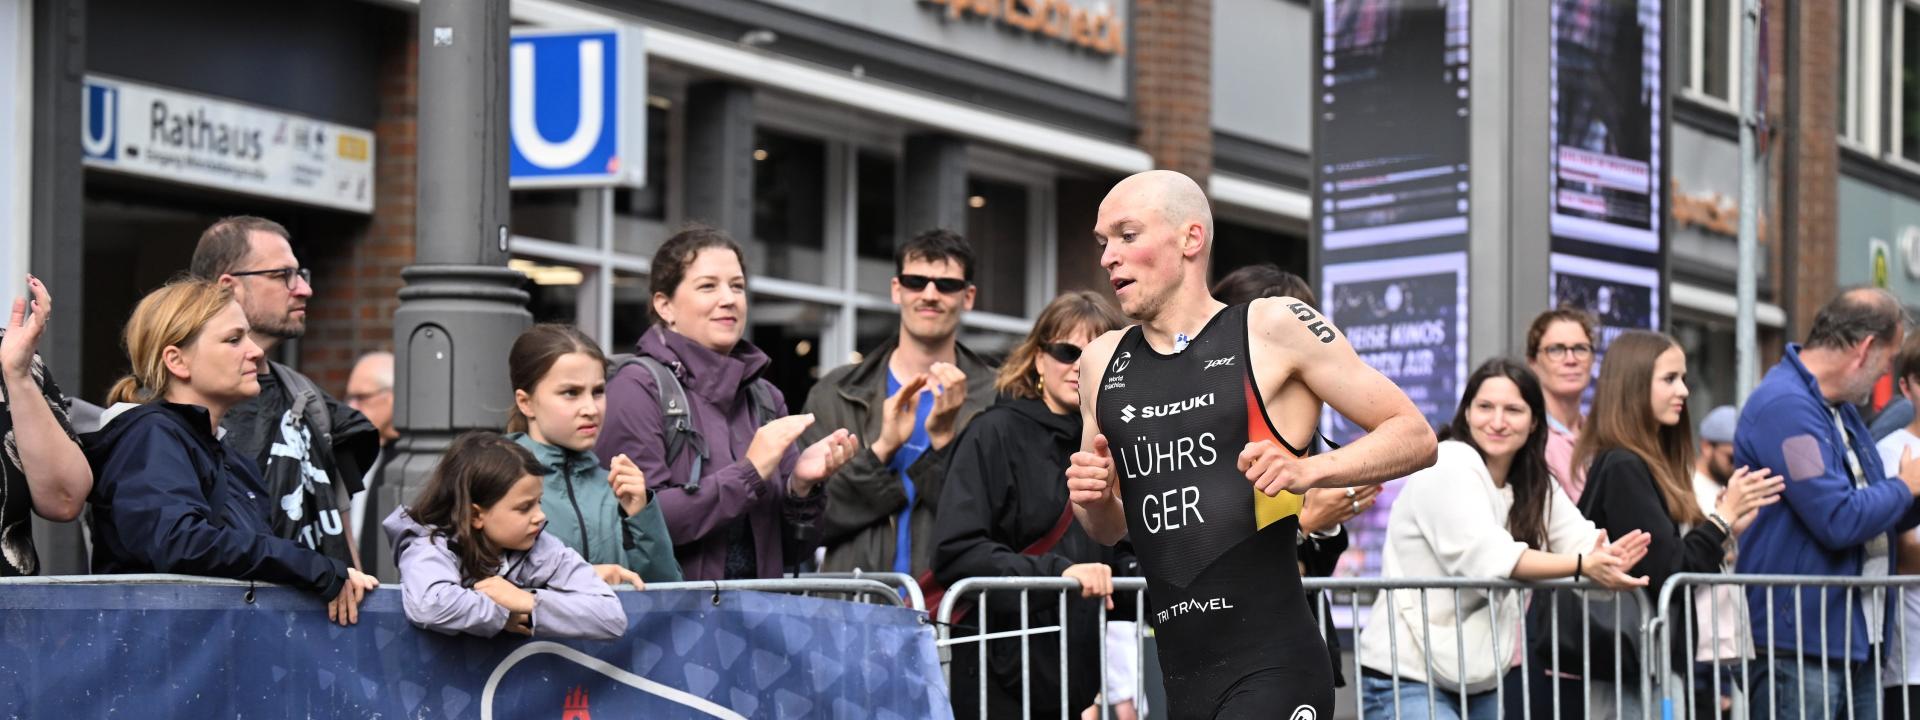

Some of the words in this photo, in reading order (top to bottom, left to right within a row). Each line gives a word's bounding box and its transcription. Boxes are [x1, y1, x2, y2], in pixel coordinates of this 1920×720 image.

[82, 83, 113, 156] U
[510, 38, 604, 170] U
[150, 100, 263, 161] Rathaus
[1286, 302, 1336, 344] 55
[1141, 393, 1215, 419] SUZUKI
[1120, 432, 1218, 479] LÜHRS
[1142, 486, 1205, 534] GER
[1157, 610, 1170, 625] TRI
[1170, 597, 1234, 618] TRAVEL
